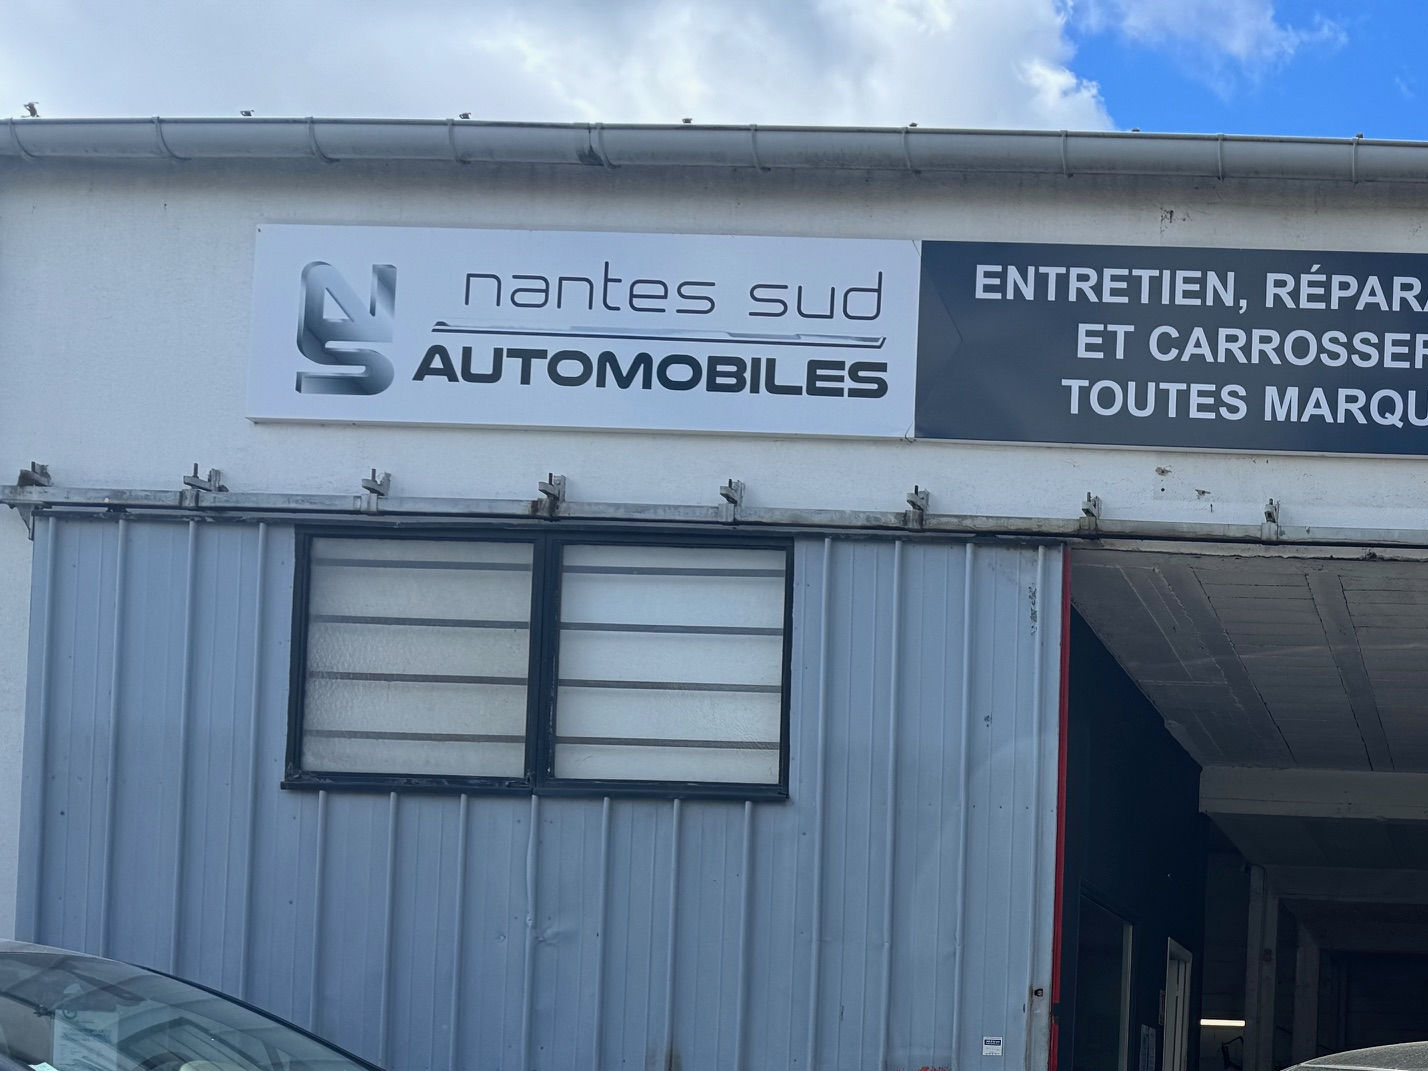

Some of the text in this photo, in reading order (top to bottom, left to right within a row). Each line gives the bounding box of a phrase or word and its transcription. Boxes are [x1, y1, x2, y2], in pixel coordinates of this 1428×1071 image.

[465, 261, 882, 320] nantes sud
[976, 265, 1247, 314] ENTRETIEN,
[1078, 323, 1134, 359] ET
[412, 345, 888, 398] AUTOMOBILES
[1062, 379, 1247, 420] TOUTES
